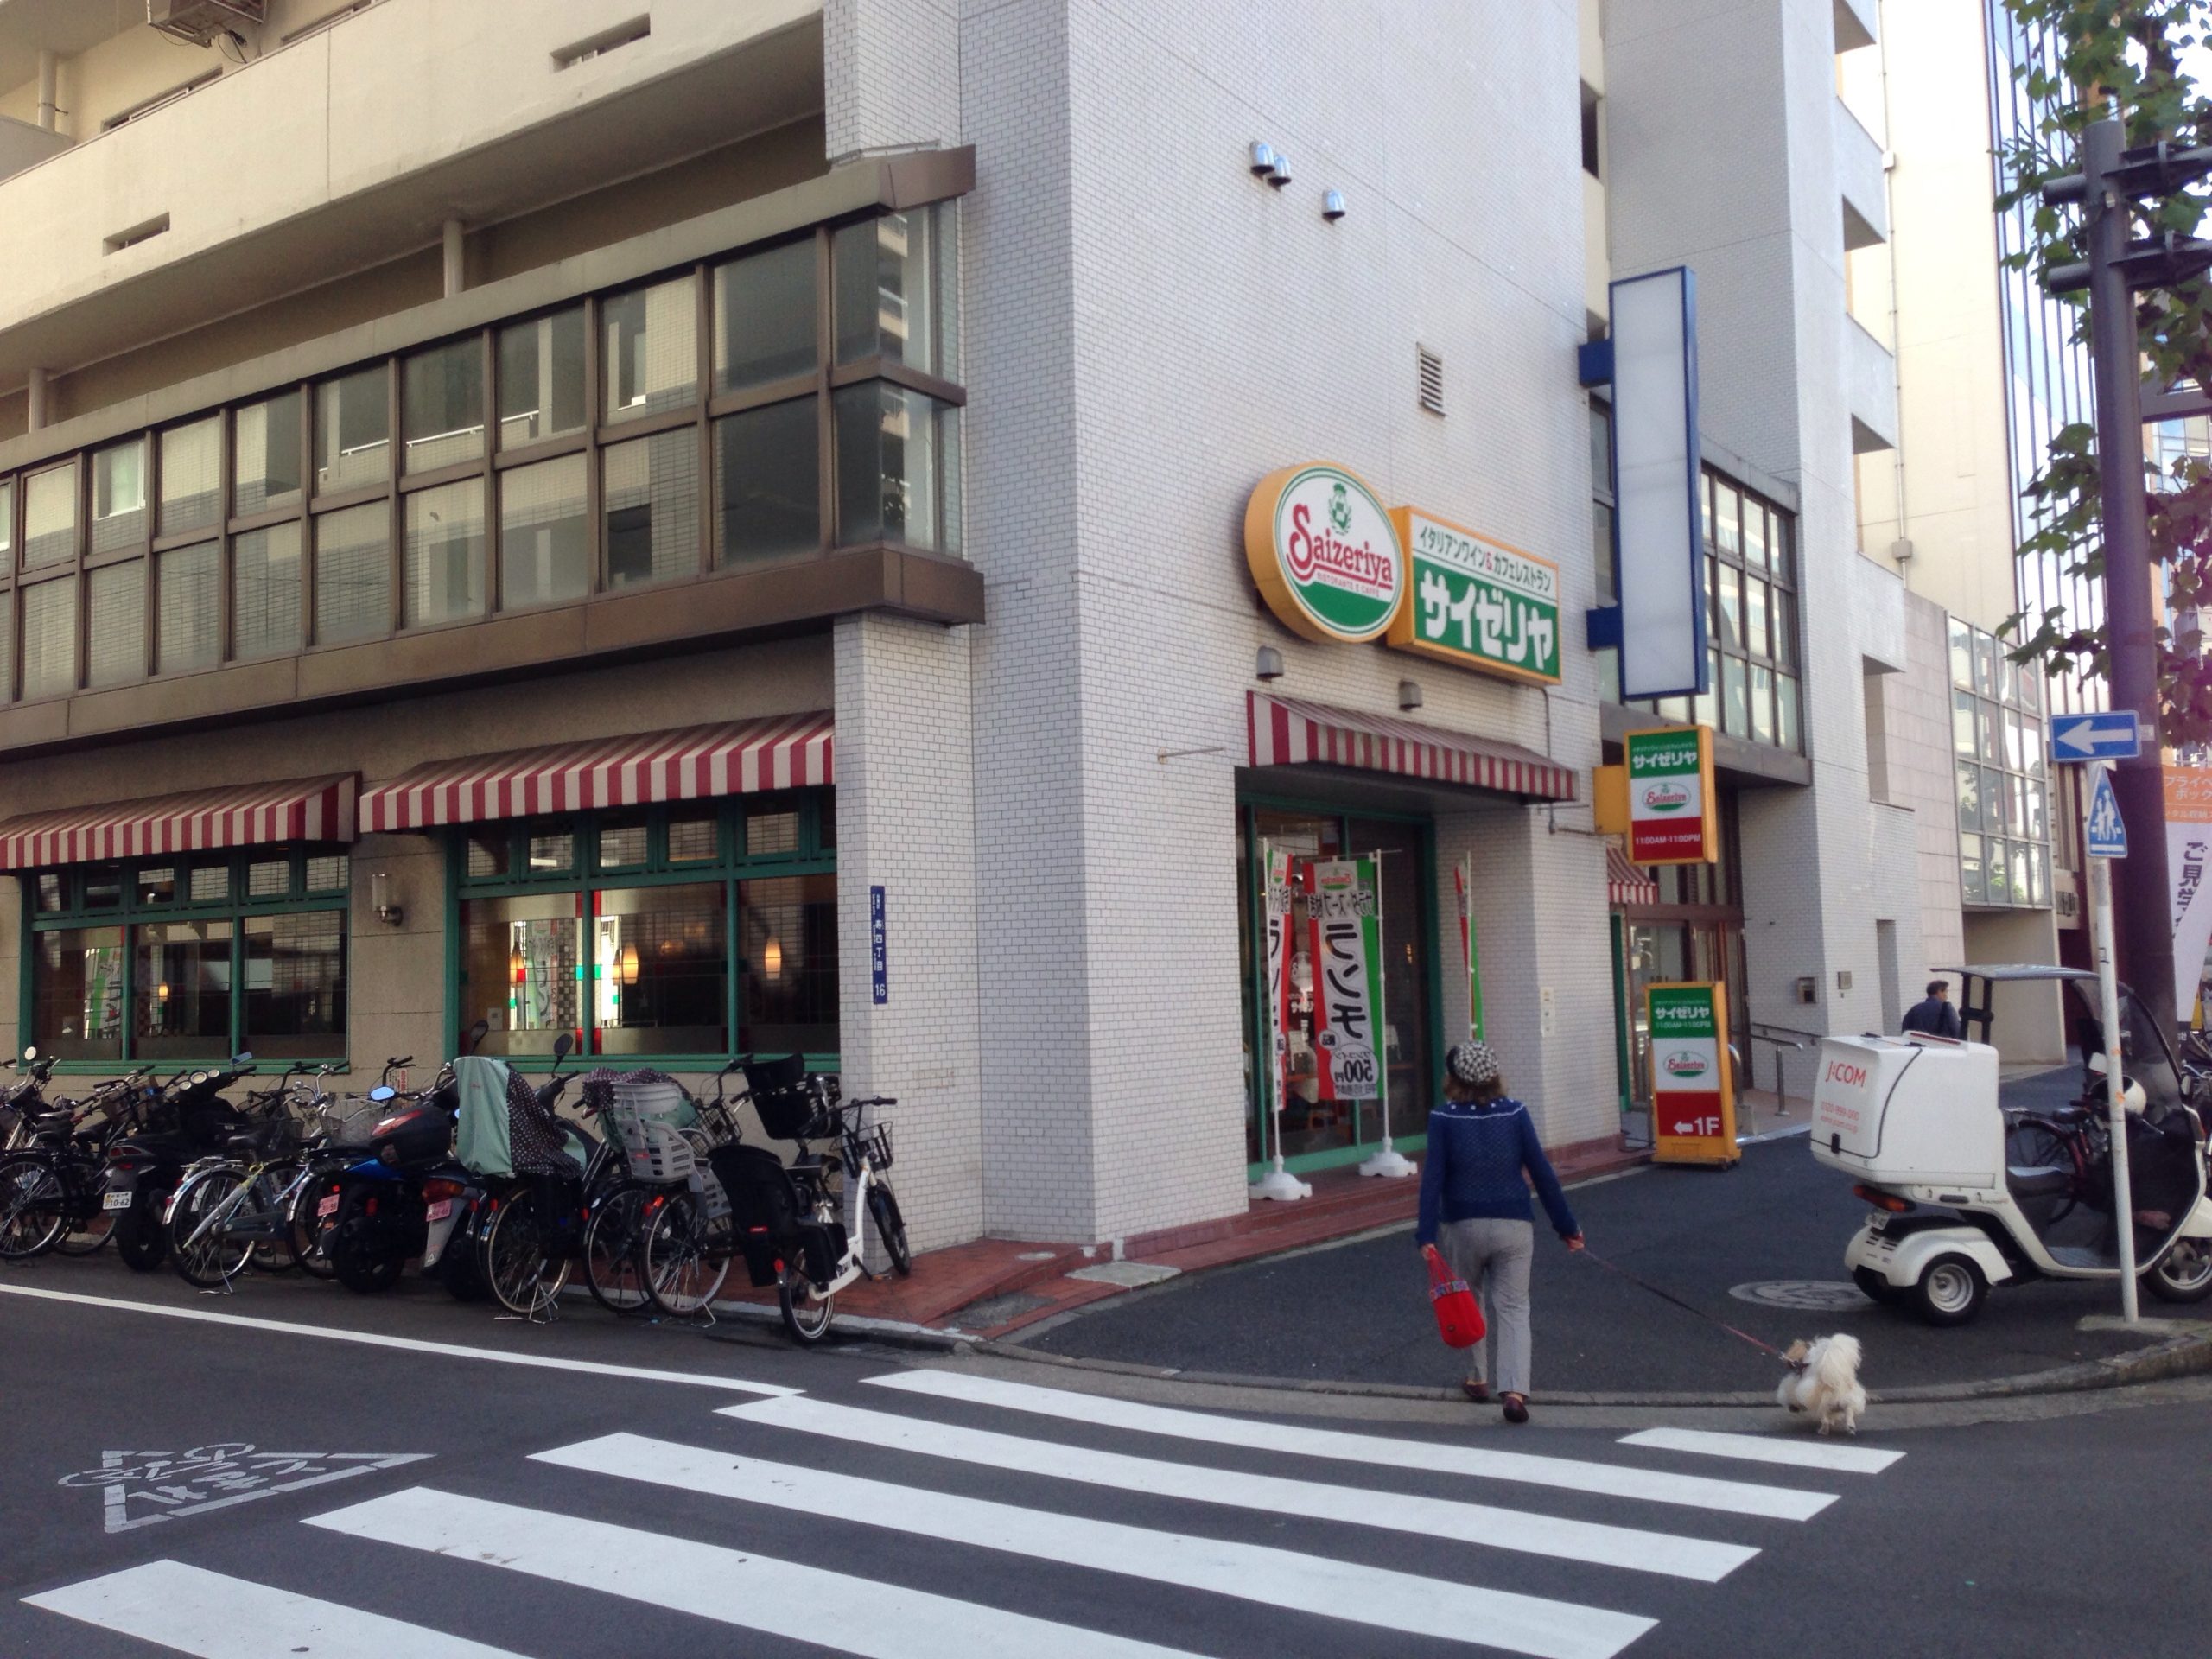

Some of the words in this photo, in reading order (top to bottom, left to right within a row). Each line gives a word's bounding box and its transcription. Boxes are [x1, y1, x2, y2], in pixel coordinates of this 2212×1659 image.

[1287, 504, 1394, 585] Saizeriya
[1420, 569, 1553, 670] サイゼリヤ
[1632, 751, 1697, 769] サイゼリヤ
[875, 983, 886, 996] 16
[1655, 1006, 1710, 1020] サイゼリヤ
[1825, 1060, 1866, 1088] J:COM
[1694, 1116, 1719, 1136] 1F
